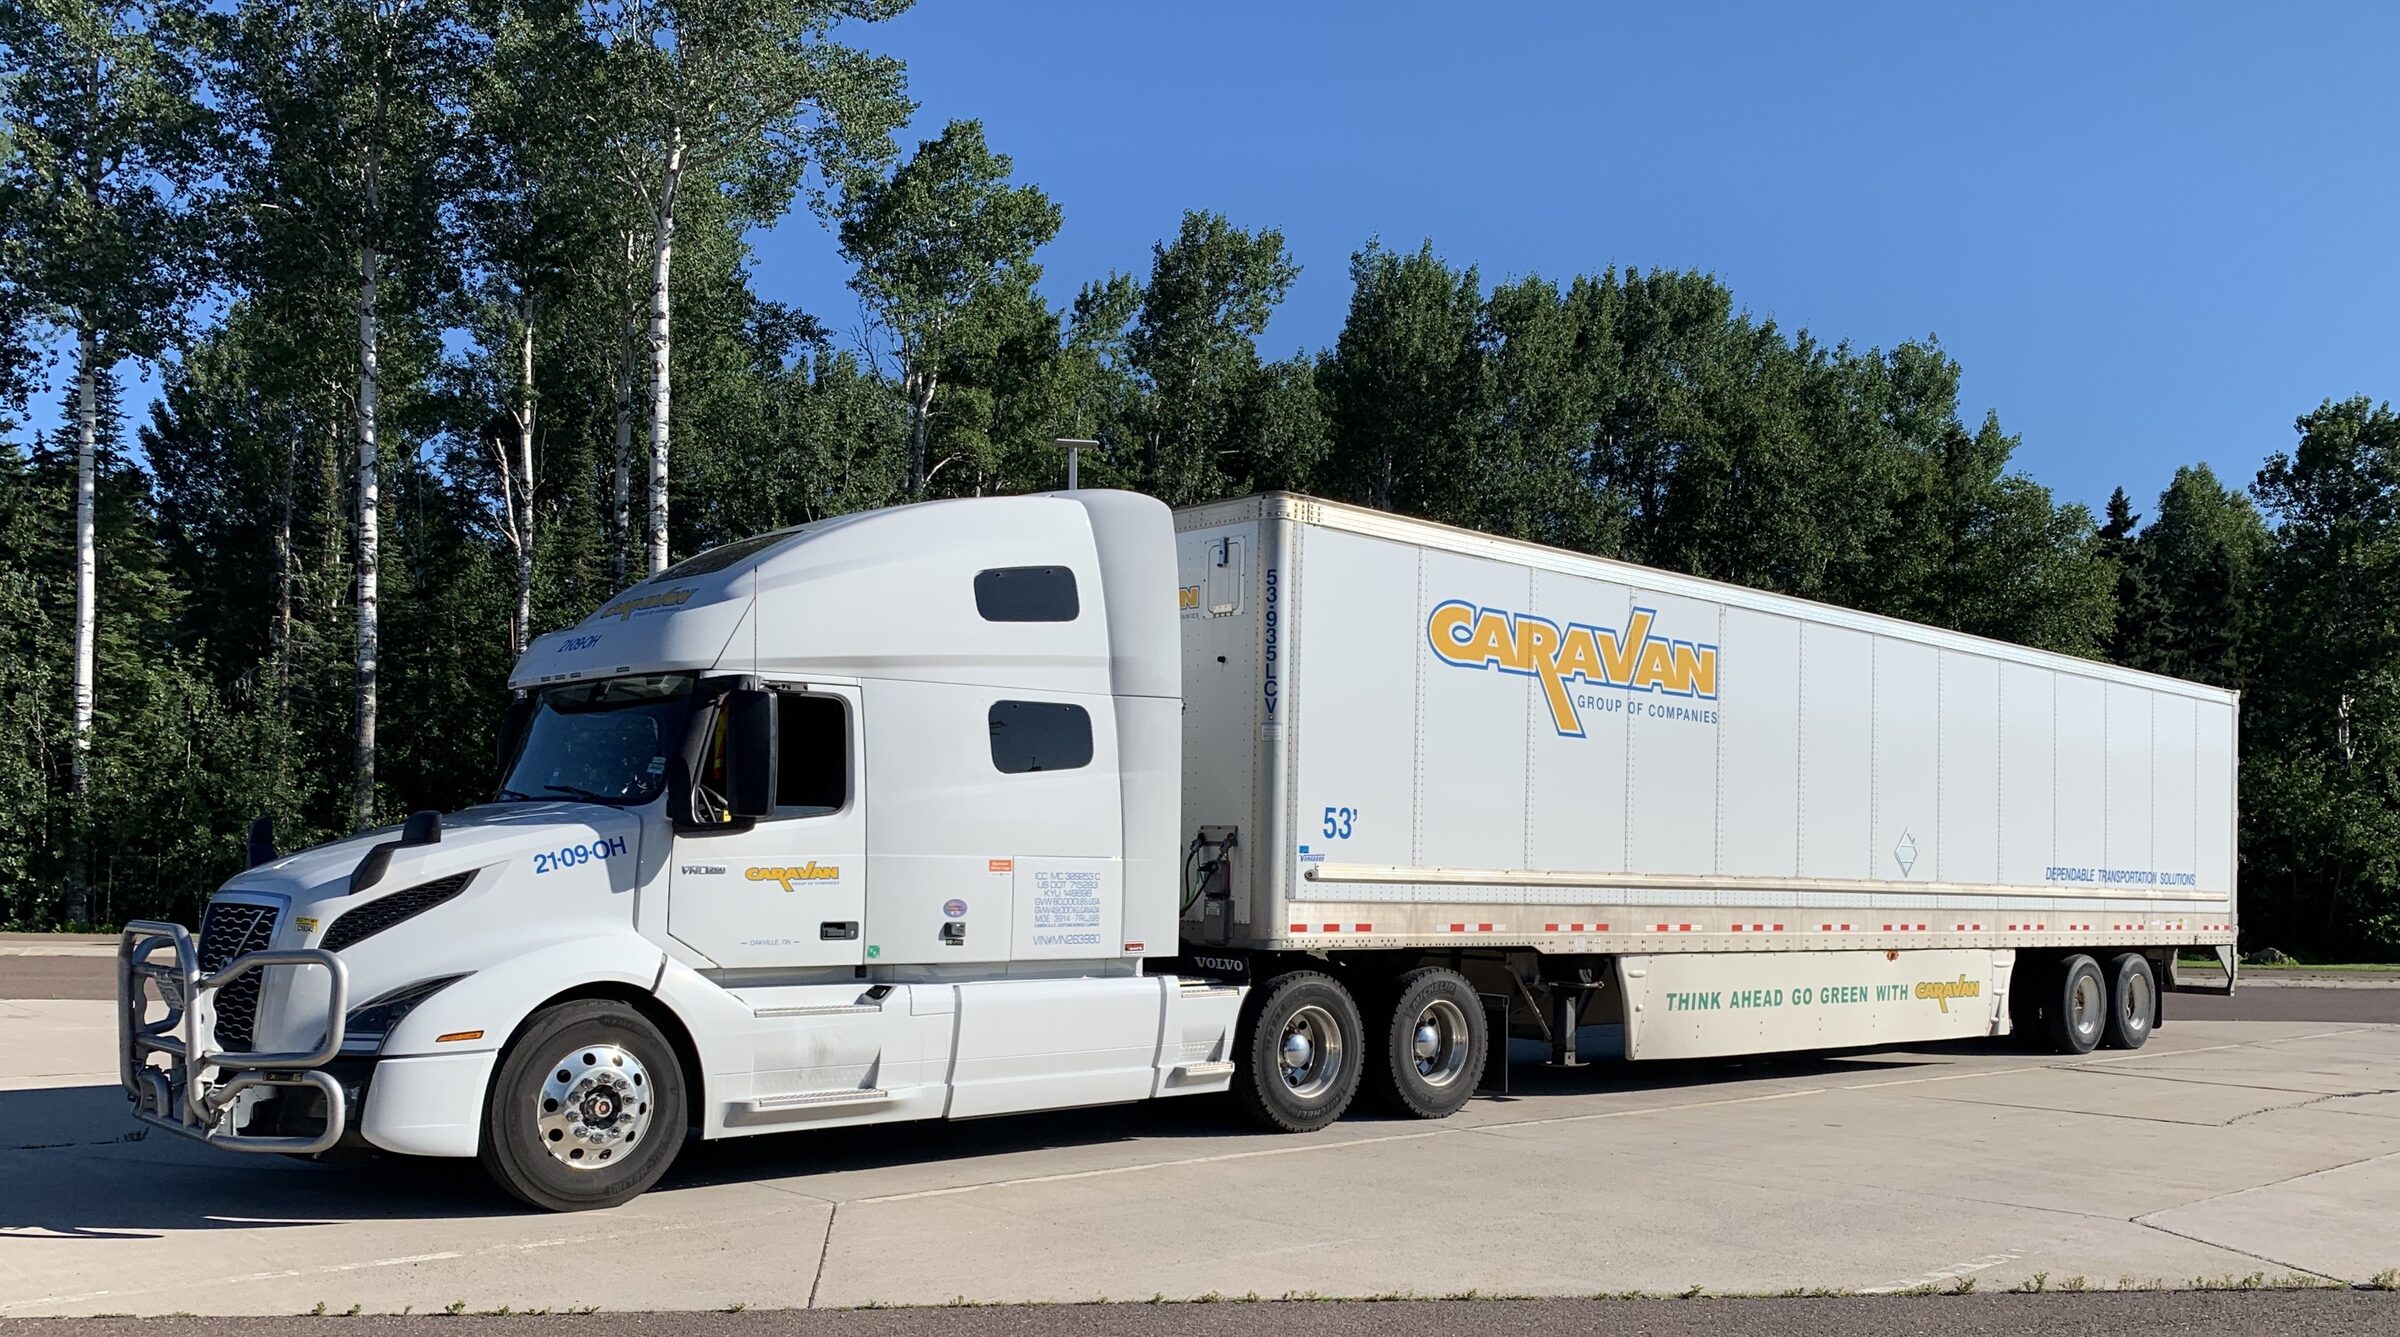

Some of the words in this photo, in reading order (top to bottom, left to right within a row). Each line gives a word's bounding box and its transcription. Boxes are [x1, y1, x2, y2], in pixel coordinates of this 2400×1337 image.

[1427, 599, 1718, 739] CARAVAN
[1577, 694, 1622, 712] GROUP
[1628, 701, 1643, 715] OF
[1649, 704, 1718, 724] COMPANIES
[1323, 806, 1358, 839] 53'
[745, 861, 840, 892] CARAVAN
[1037, 880, 1049, 889] US
[1050, 880, 1067, 889] DOT
[1050, 872, 1064, 881] MC
[2045, 867, 2095, 882] DEPENDABLE
[2098, 869, 2158, 885] TRANSPORTATION
[2159, 872, 2196, 886] SOLUTIONS
[1194, 956, 1243, 971] VOLVO
[1666, 991, 1722, 1011] THINK
[1729, 988, 1783, 1009] AHEAD
[1792, 987, 1813, 1005] GO
[1820, 985, 1868, 1004] GREEN
[1876, 984, 1909, 1001] WITH
[1915, 974, 1980, 1013] CARAVAN
